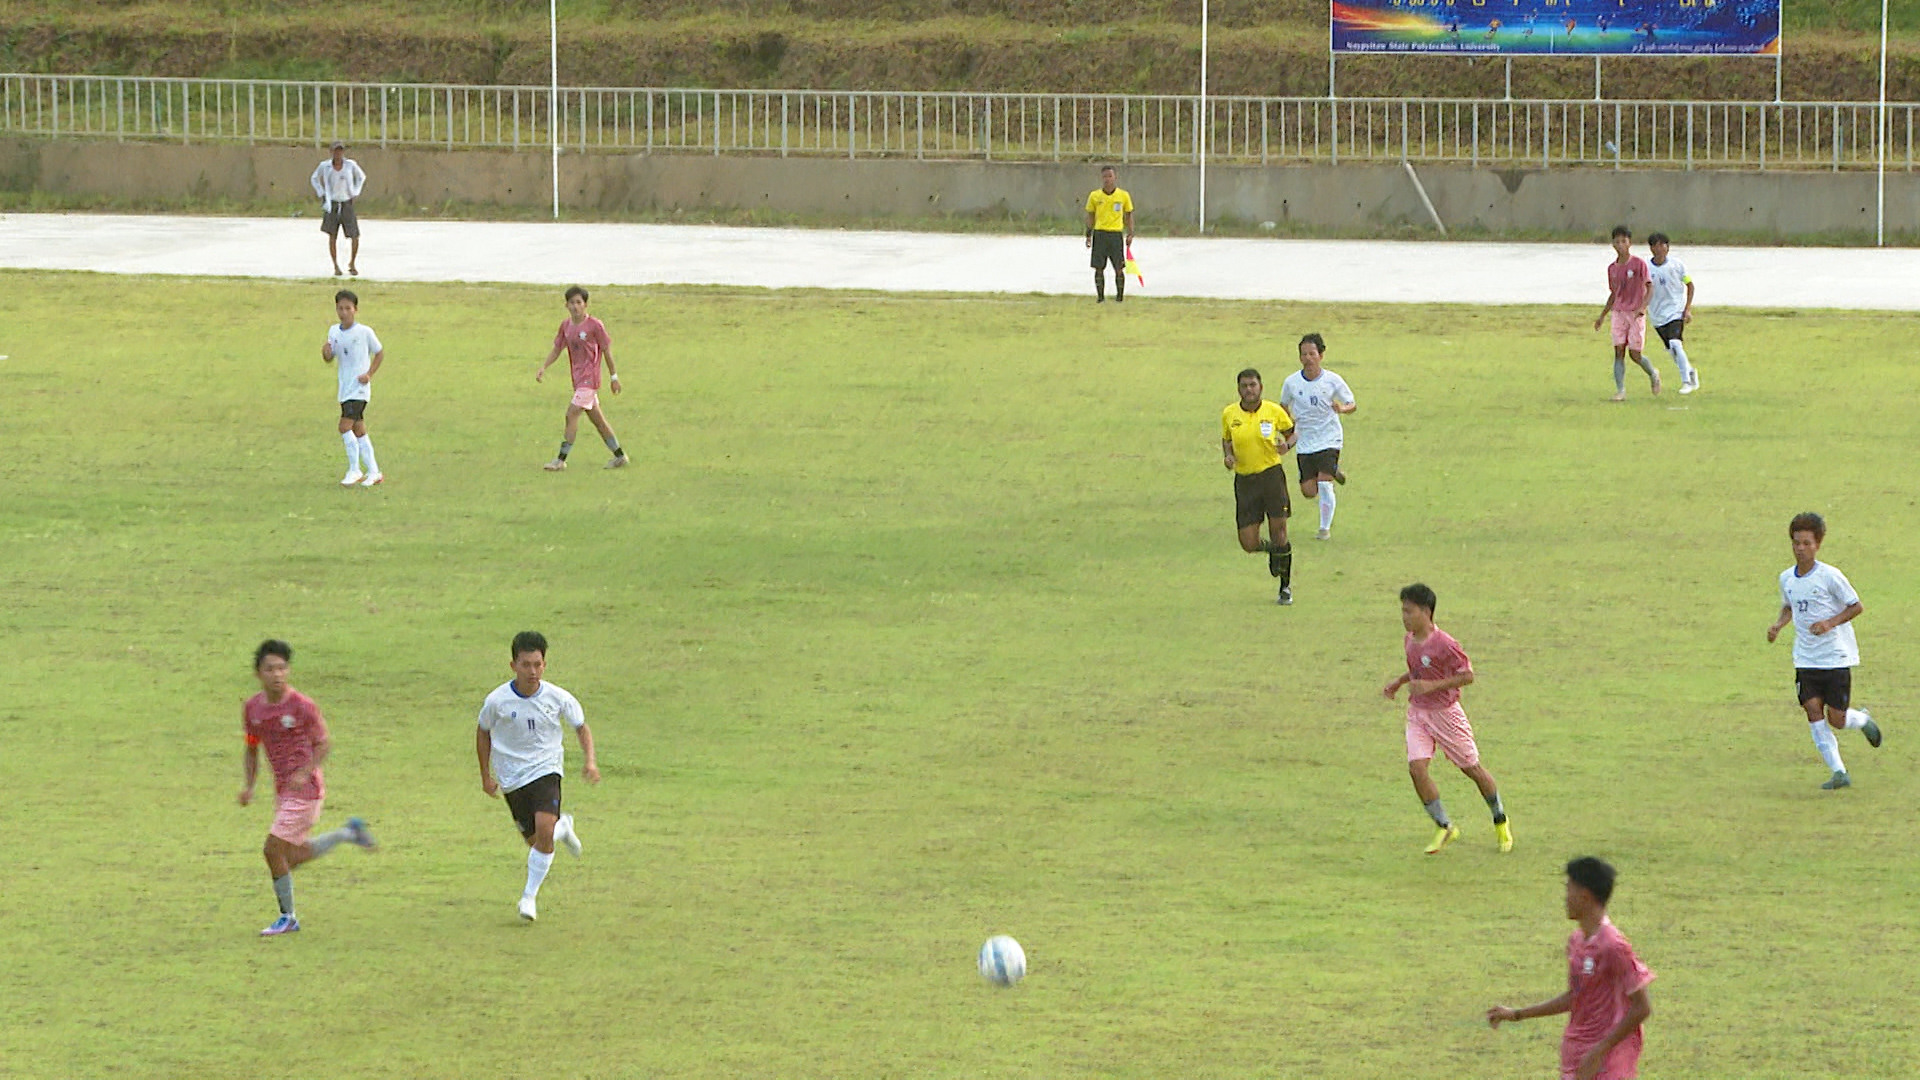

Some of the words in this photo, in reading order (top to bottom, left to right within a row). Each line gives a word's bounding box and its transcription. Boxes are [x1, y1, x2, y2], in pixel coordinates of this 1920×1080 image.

[1388, 42, 1409, 50] State
[1460, 42, 1500, 52] University
[1309, 395, 1319, 406] 10
[527, 719, 536, 730] 11
